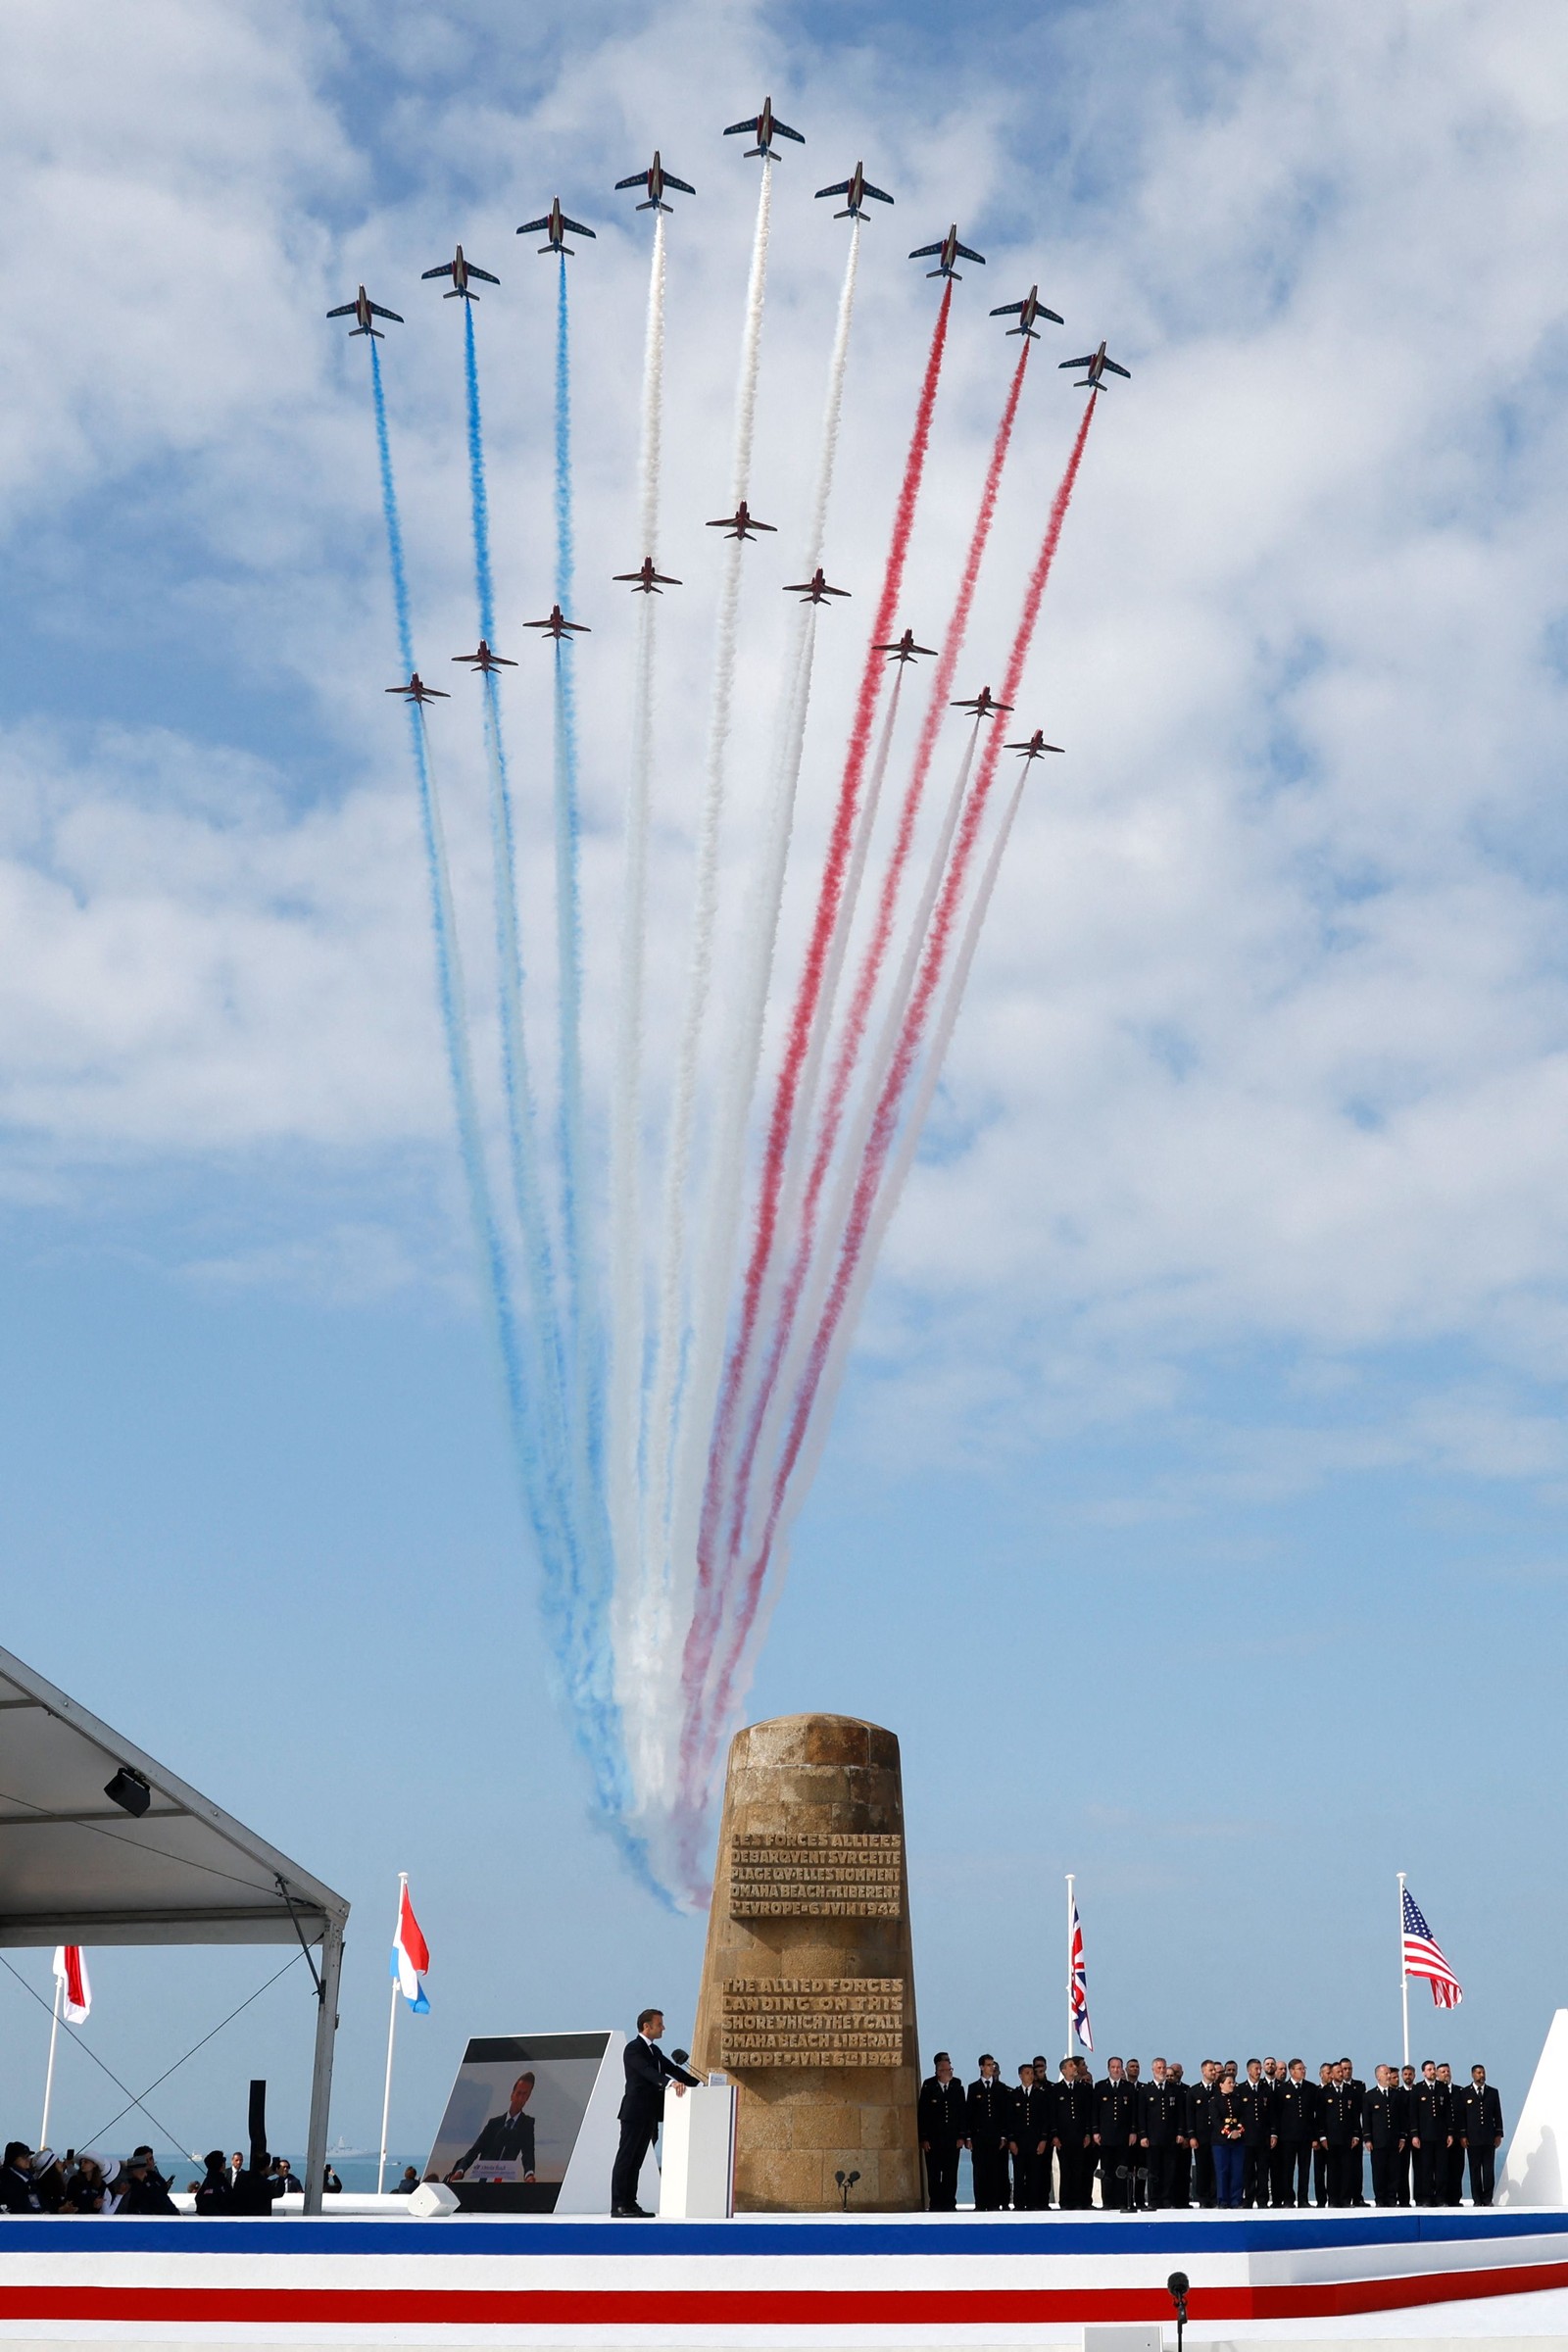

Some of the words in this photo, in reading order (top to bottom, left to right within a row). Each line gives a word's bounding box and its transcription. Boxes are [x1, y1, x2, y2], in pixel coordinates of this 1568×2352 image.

[733, 1835, 761, 1846] LES
[765, 1835, 828, 1846] FORCES
[831, 1835, 901, 1847] ALLIEES
[732, 1851, 825, 1864] DEBARQVENT
[829, 1851, 857, 1864] SVR
[858, 1851, 901, 1864] CETTE
[731, 1868, 772, 1881] PLAGE
[835, 1868, 900, 1881] NOMMENT
[731, 1885, 780, 1897] OMAHA
[780, 1885, 826, 1897] BEACH
[836, 1885, 900, 1897] LIBERENT
[808, 1902, 819, 1915] 6
[821, 1902, 857, 1915] JVIN
[860, 1902, 901, 1915] 1944
[723, 1979, 756, 1992] THE
[760, 1979, 824, 1992] ALLIED
[828, 1979, 903, 1992] FORCES
[723, 1997, 810, 2011] LANDING
[820, 1997, 848, 2011] ON
[856, 1997, 903, 2011] THIS
[722, 2015, 775, 2030] SHORE
[776, 2015, 824, 2030] WHICH
[824, 2015, 860, 2030] THEY
[863, 2015, 903, 2030] CALL
[722, 2034, 776, 2047] OMAHA
[779, 2034, 830, 2047] BEACH
[833, 2034, 903, 2047] LIBERATE
[860, 2052, 903, 2066] 1944
